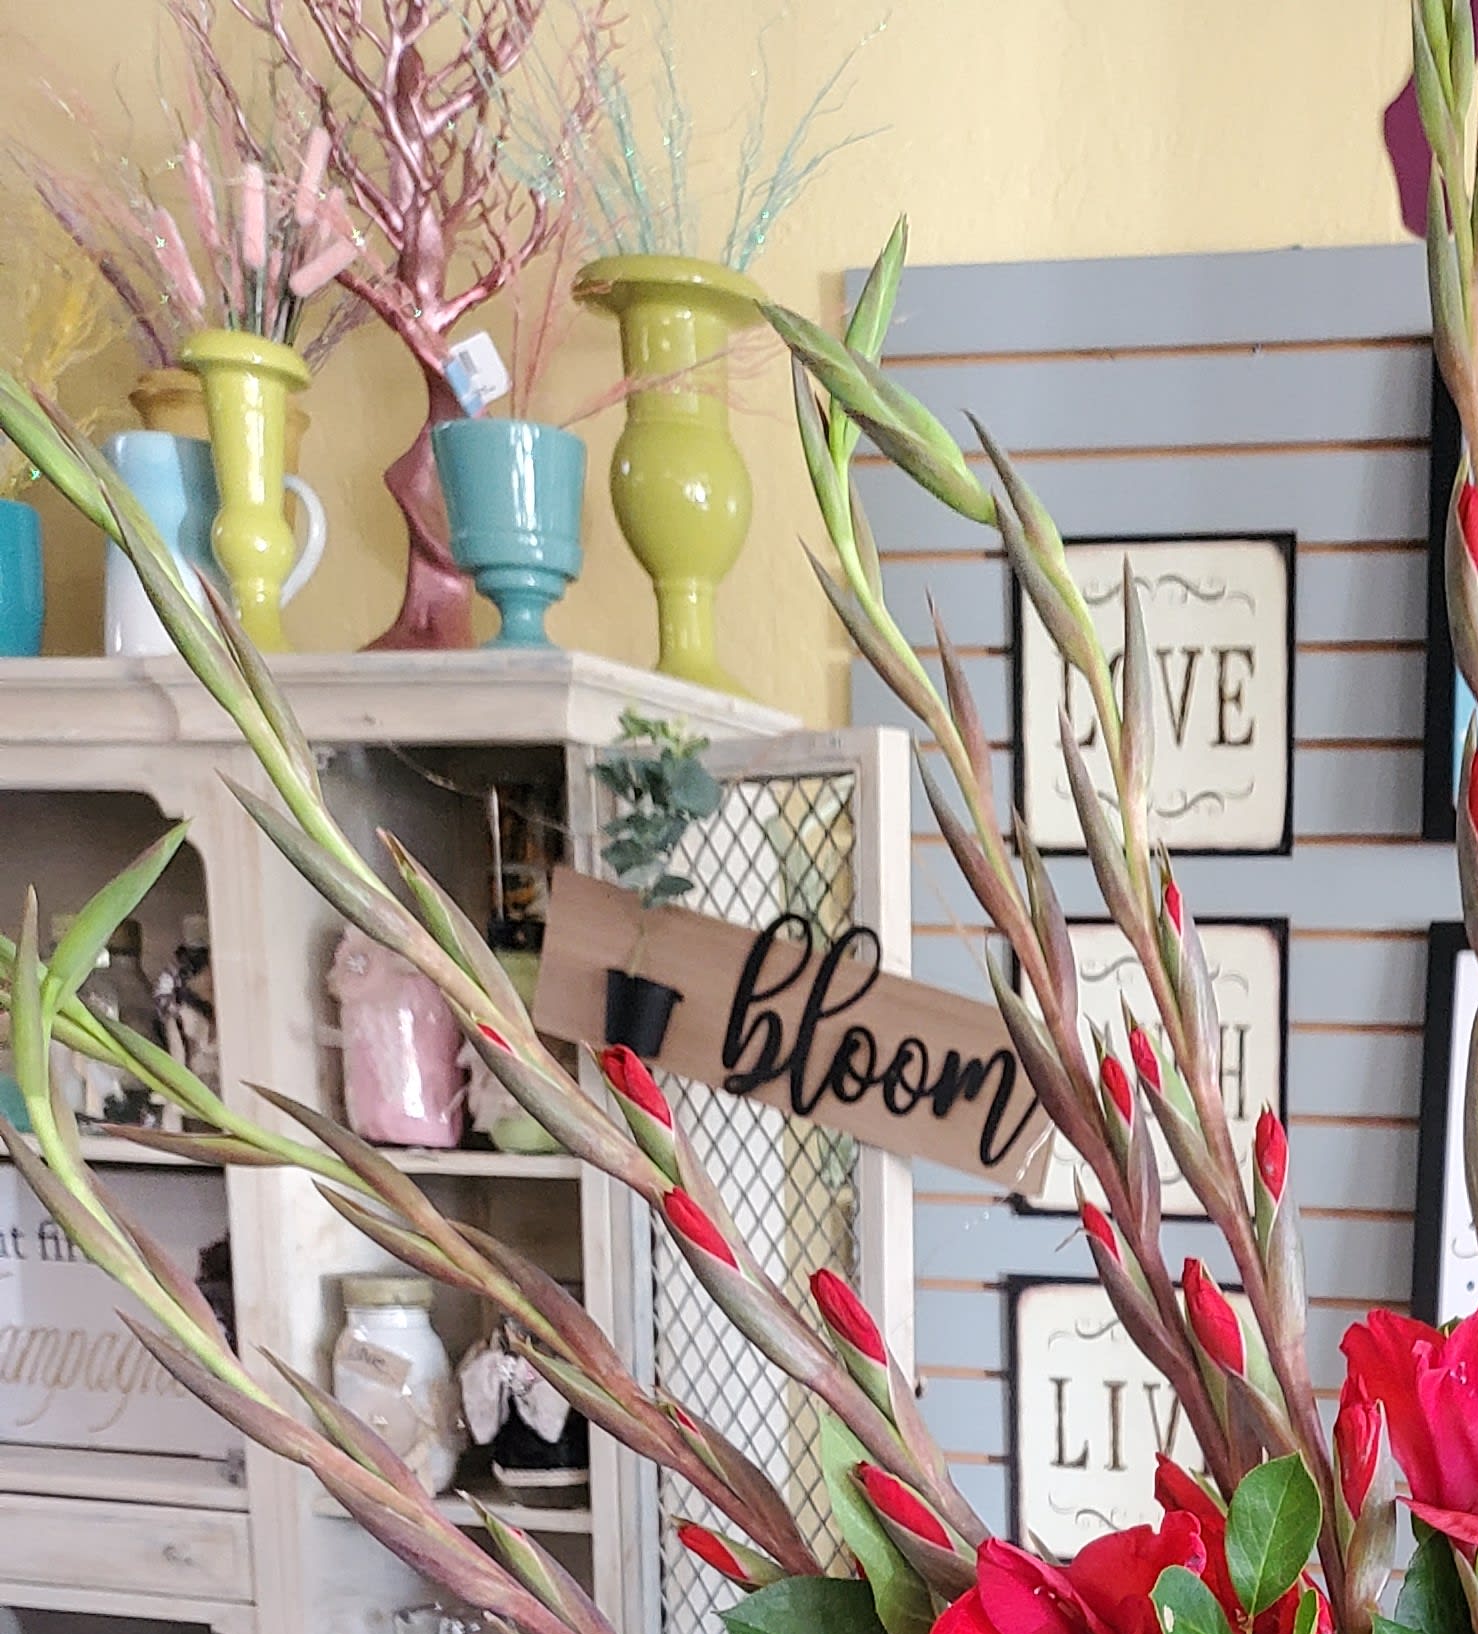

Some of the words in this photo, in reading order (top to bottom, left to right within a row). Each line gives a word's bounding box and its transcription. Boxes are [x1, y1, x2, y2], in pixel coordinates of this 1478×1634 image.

[1056, 646, 1256, 748] LVE
[721, 912, 1039, 1168] bloom
[1048, 1377, 1214, 1478] LIV
